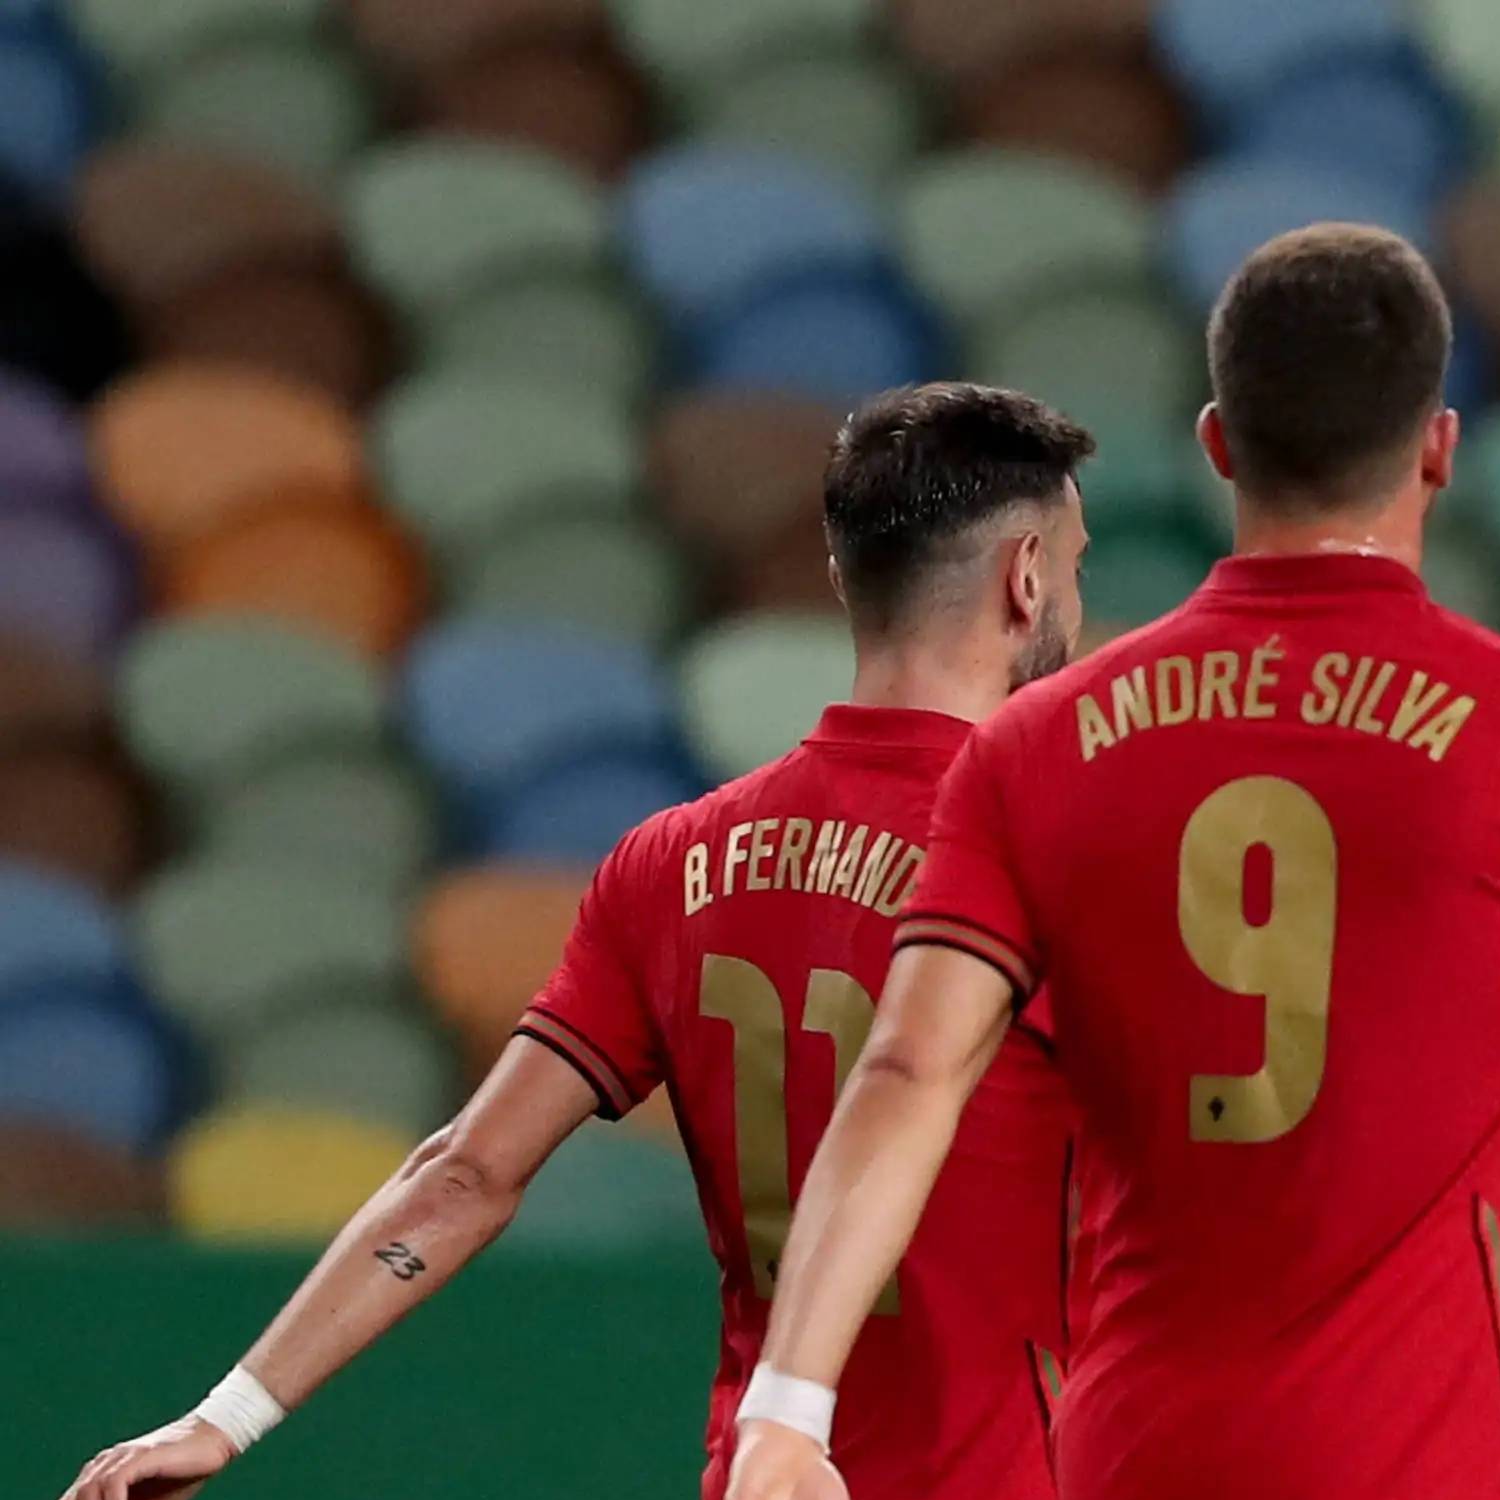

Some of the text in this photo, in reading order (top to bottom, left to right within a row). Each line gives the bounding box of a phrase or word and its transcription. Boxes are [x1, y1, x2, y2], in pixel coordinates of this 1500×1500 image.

[1076, 634, 1476, 762] ANDRÉ SILVA
[684, 842, 714, 917] B.
[1178, 775, 1337, 1142] 9
[374, 1241, 426, 1281] 23
